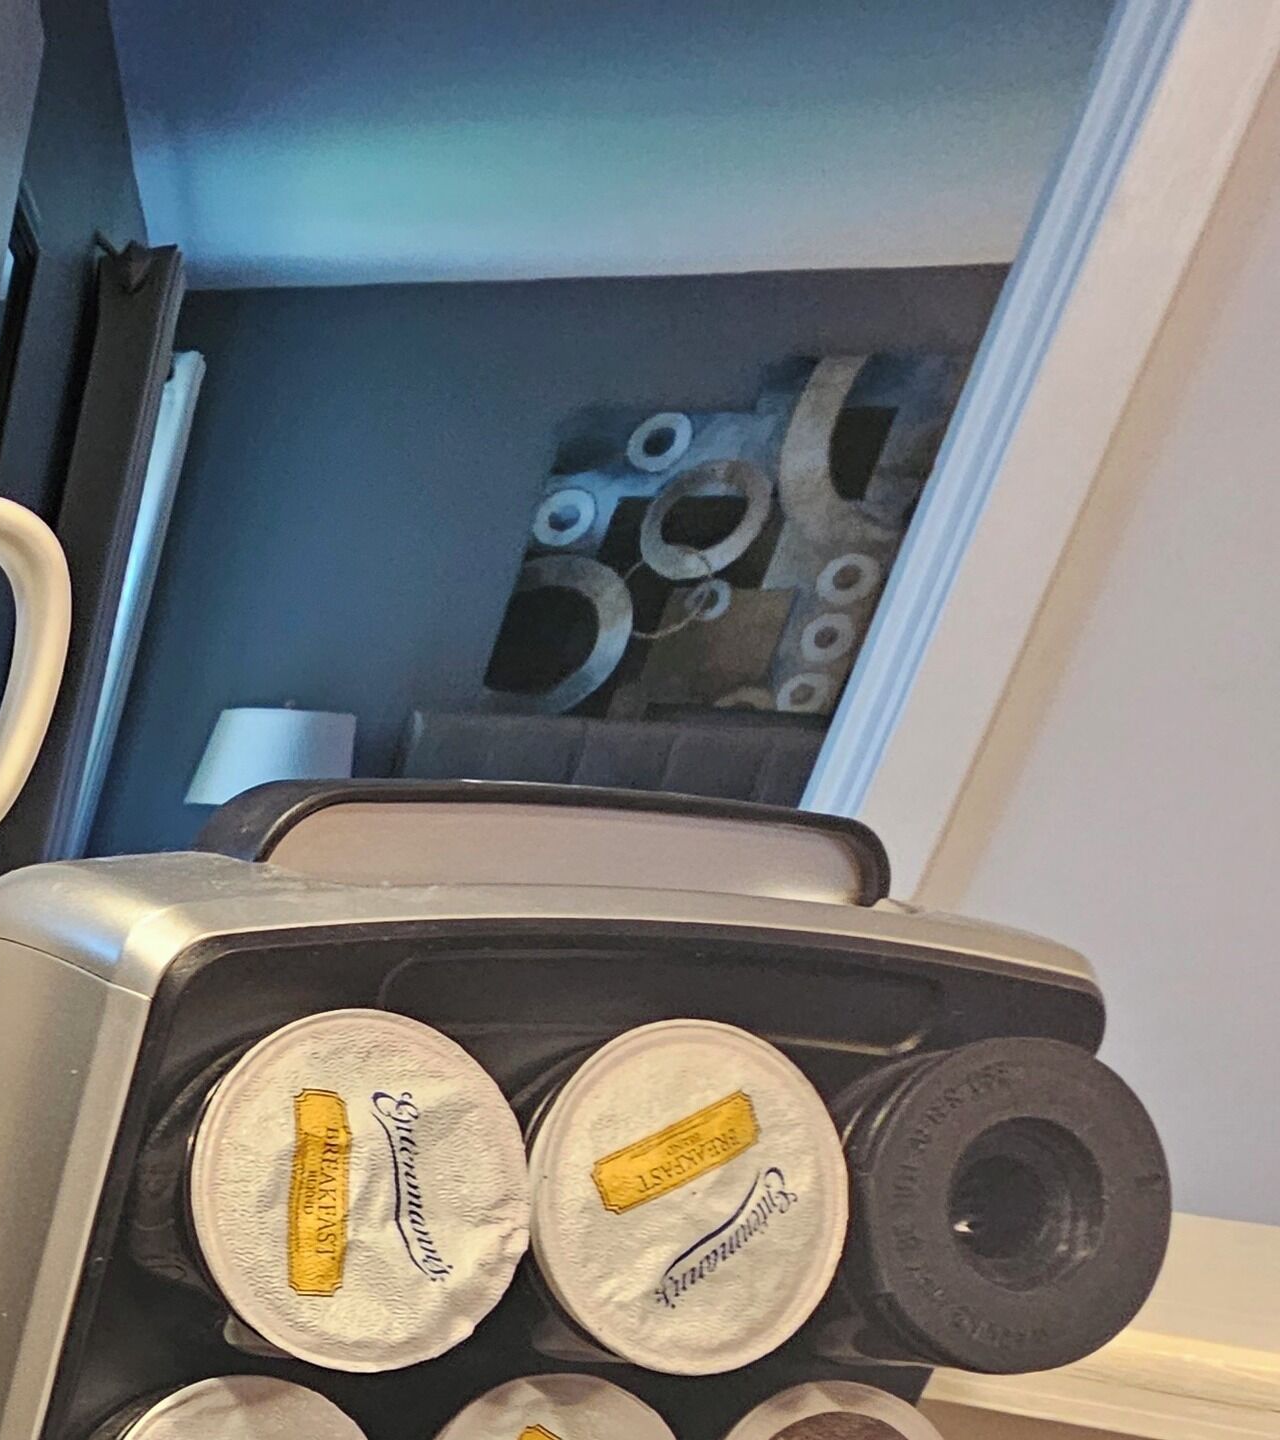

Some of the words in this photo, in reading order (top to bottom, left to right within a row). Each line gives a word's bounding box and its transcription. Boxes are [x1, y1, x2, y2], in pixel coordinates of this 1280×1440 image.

[315, 1126, 341, 1257] BREAKFAST
[370, 1090, 454, 1283] Entenmann's
[637, 1126, 740, 1194] BREAKFAST
[653, 1166, 801, 1309] Entenmann's
